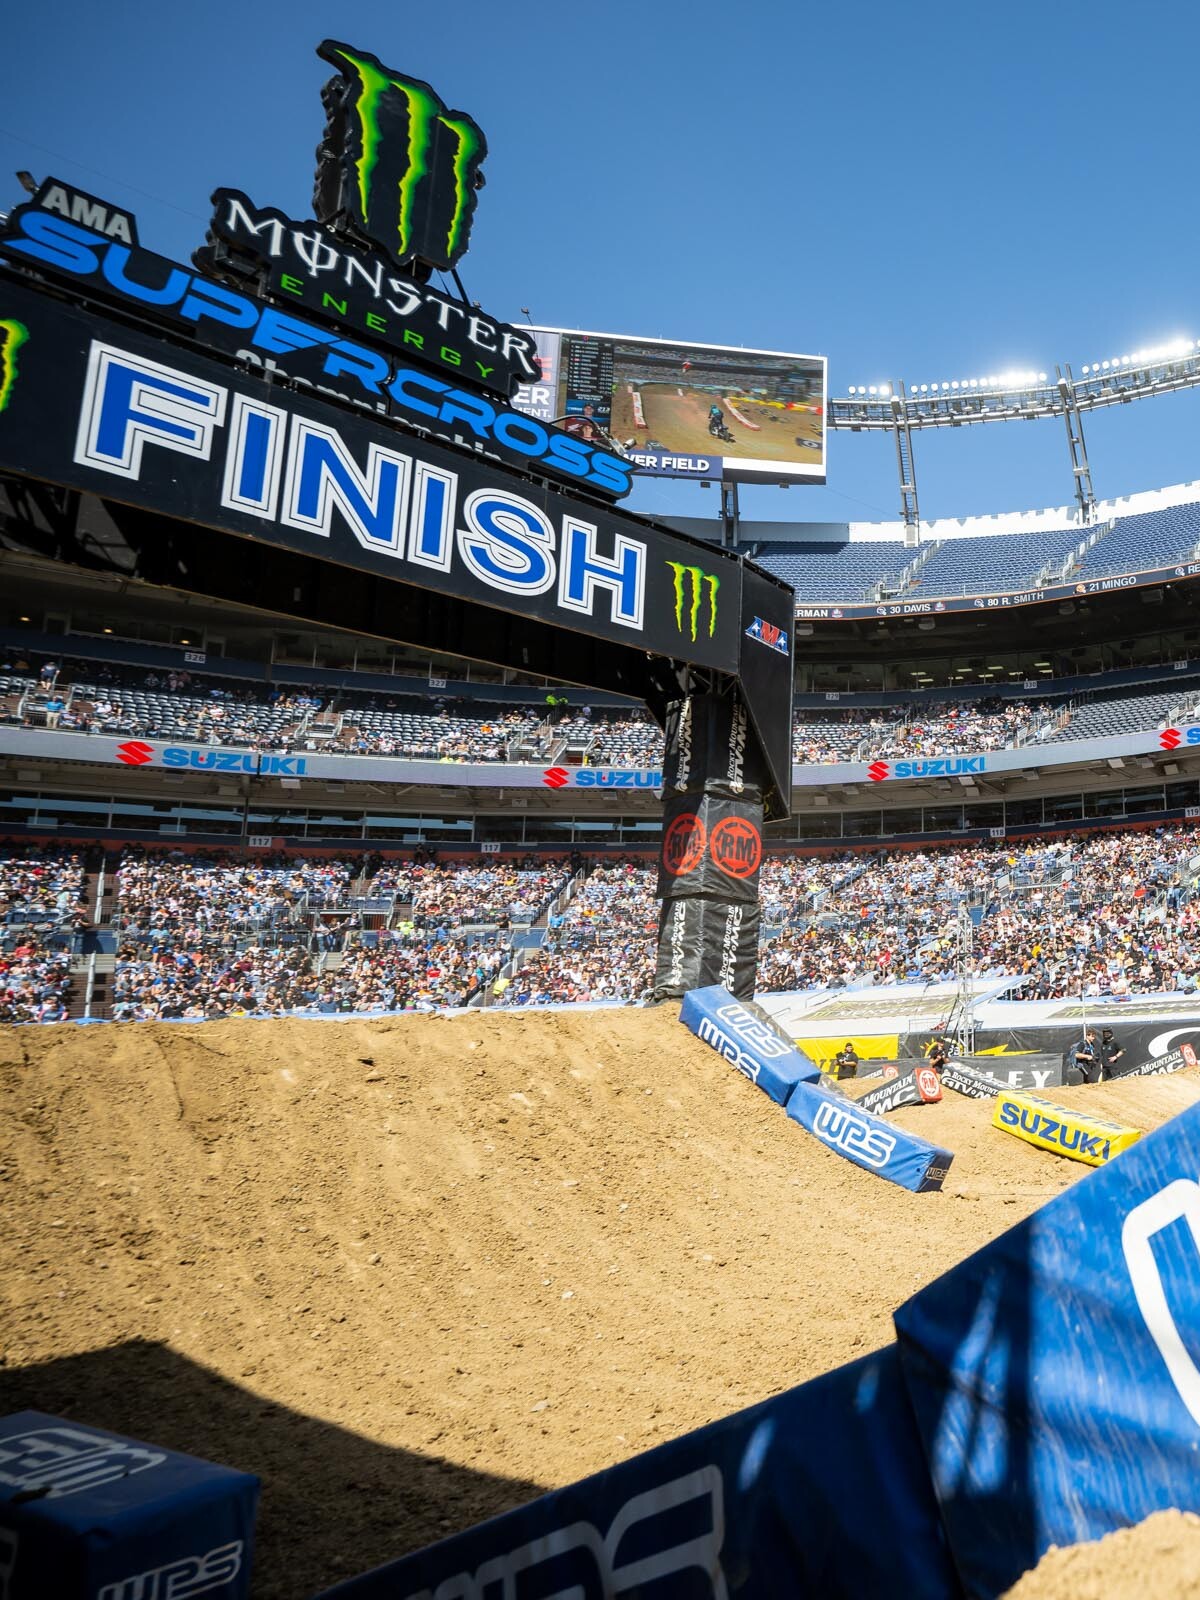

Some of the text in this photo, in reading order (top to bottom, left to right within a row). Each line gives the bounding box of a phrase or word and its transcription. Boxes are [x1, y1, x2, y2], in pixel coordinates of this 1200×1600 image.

[41, 183, 133, 245] AMA
[226, 197, 535, 376] MONSTER
[281, 273, 495, 379] ENERGY
[3, 210, 641, 493] SUPERCROSS
[661, 456, 710, 472] FIELD
[74, 339, 647, 630] FINISH
[1089, 576, 1137, 592] 21 MINGO
[889, 604, 931, 614] 30 DAVIS
[987, 598, 999, 607] 80
[1013, 592, 1044, 604] SMITH
[745, 616, 789, 653] AMA
[162, 748, 305, 775] SUZUKI
[895, 757, 985, 777] SUZUKI
[1187, 809, 1199, 817] 119
[253, 837, 270, 846] 117
[484, 844, 499, 852] 117
[716, 1004, 792, 1057] WPS
[1140, 1050, 1181, 1075] MOUNTAIN
[864, 1073, 913, 1108] MOUNTAIN
[952, 1072, 973, 1086] ROCKY
[813, 1101, 897, 1168] WPS
[1000, 1102, 1110, 1161] SUZUKI
